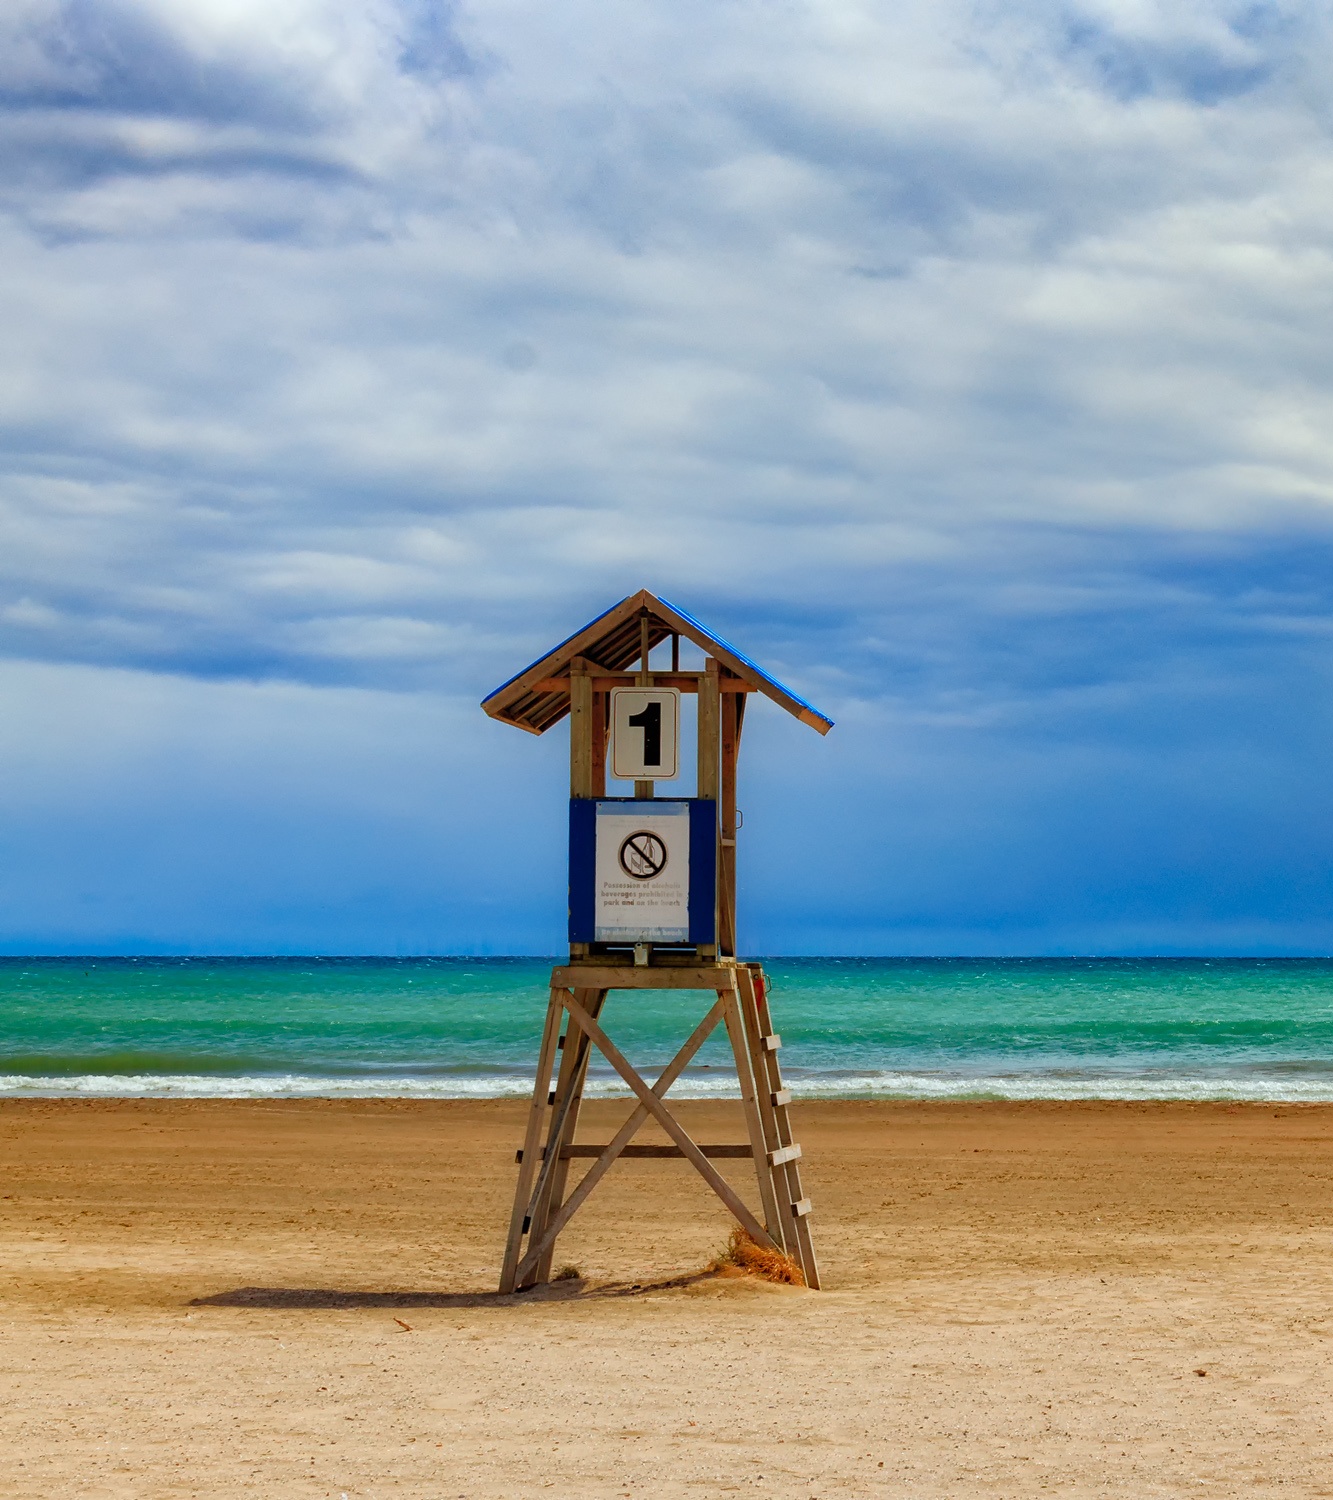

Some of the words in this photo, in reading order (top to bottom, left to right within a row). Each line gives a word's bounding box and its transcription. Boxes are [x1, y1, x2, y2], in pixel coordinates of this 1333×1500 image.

[629, 702, 661, 766] 1
[603, 881, 640, 889] Possession
[642, 881, 650, 889] of
[601, 890, 637, 898] beverages
[603, 899, 620, 907] park
